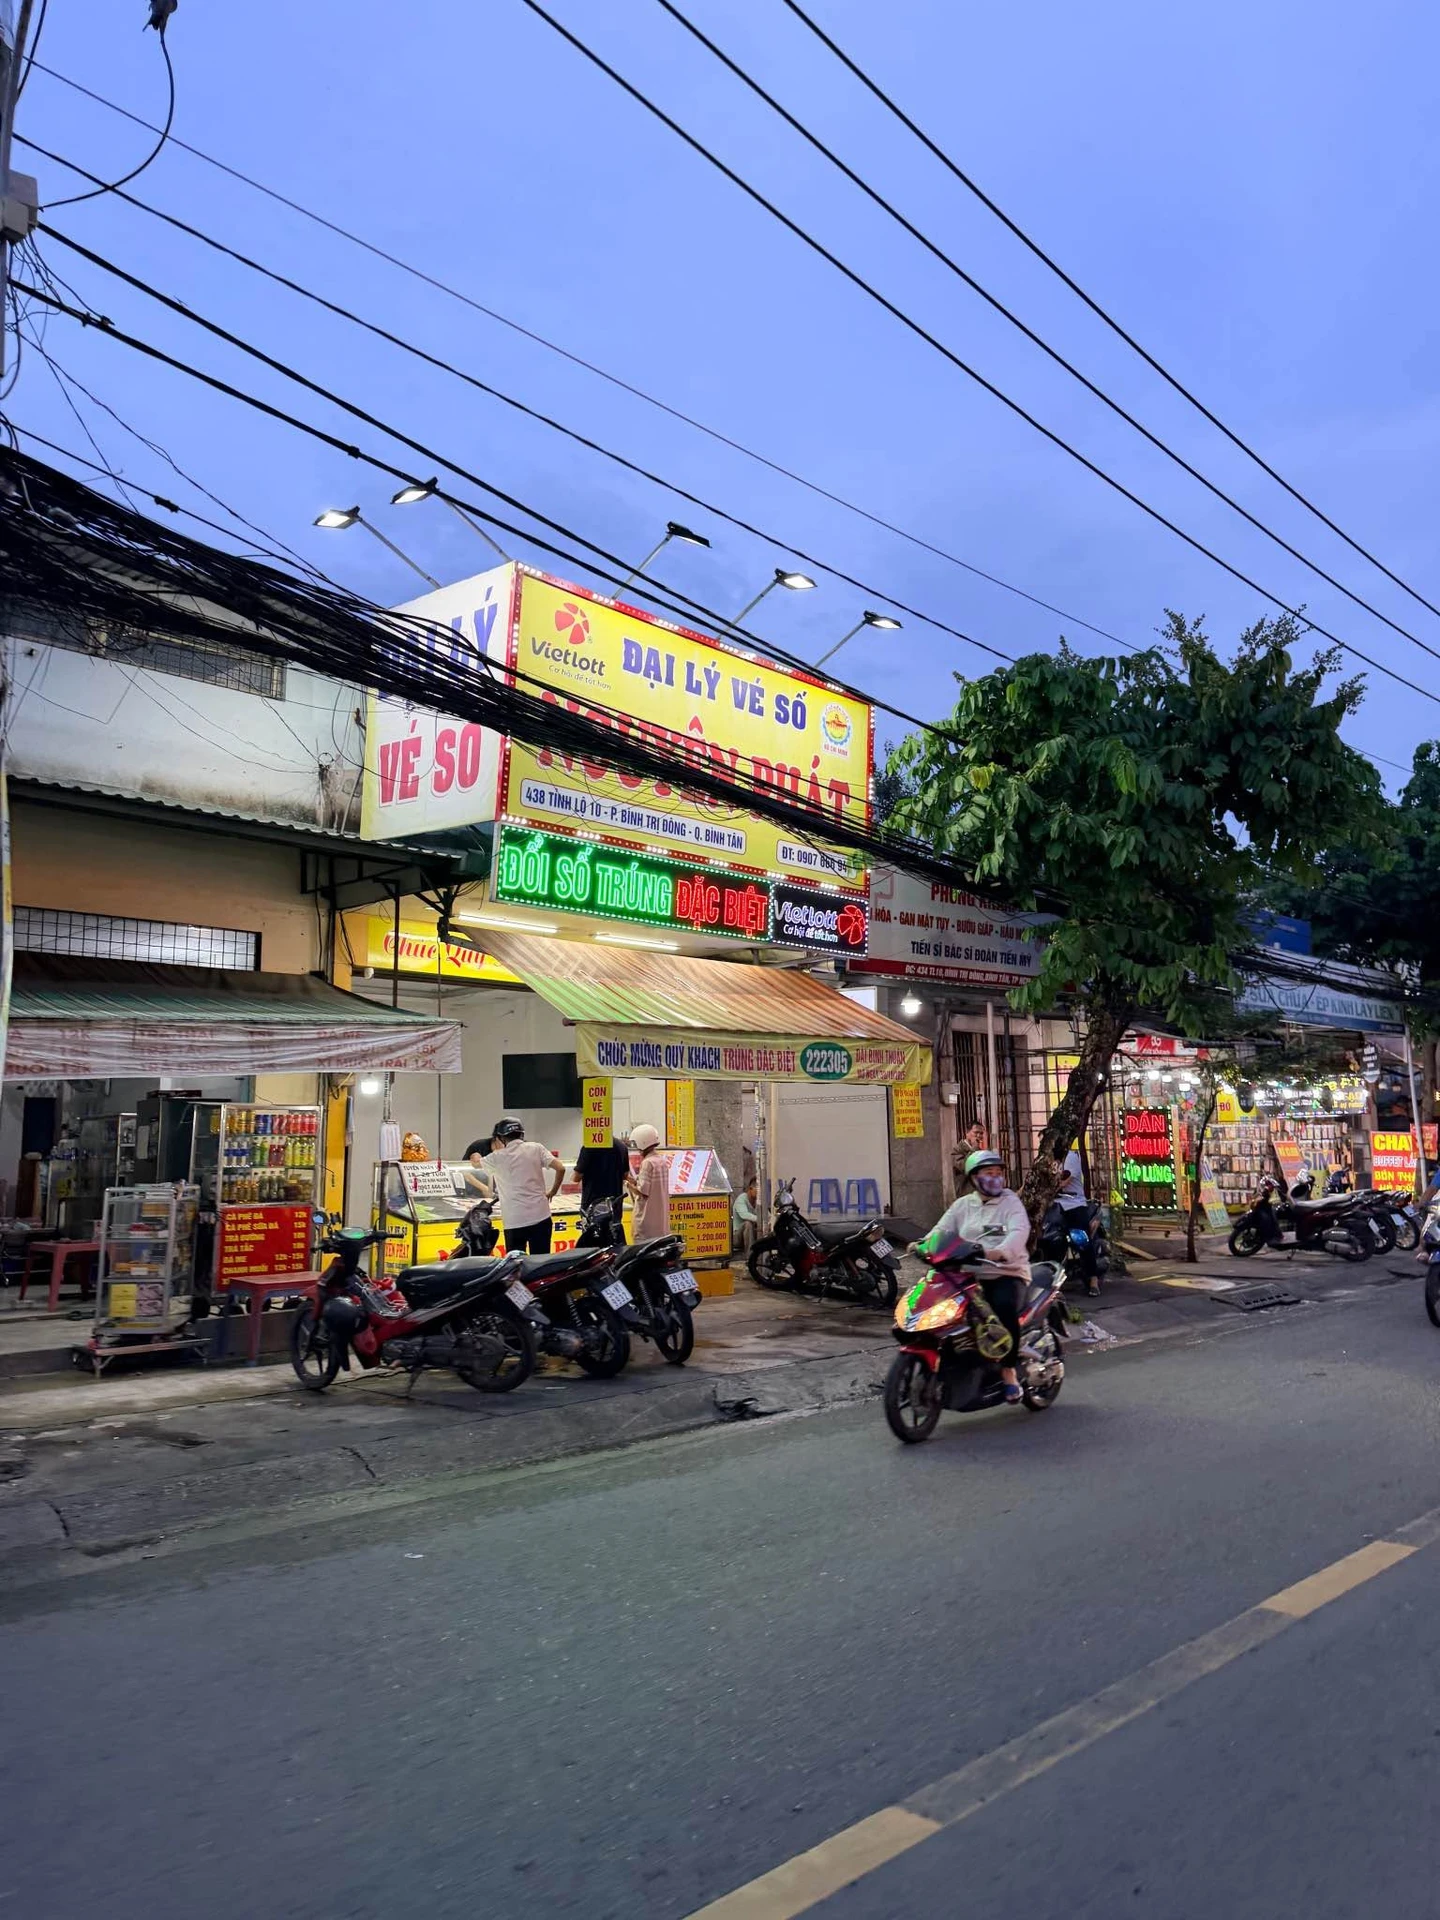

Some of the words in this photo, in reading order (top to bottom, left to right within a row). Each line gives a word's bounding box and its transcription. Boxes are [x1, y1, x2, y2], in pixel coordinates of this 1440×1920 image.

[531, 637, 605, 676] Vietlott
[622, 637, 675, 689] ĐẠI
[685, 660, 721, 700] LÝ
[731, 677, 765, 717] VÉ
[774, 691, 807, 730] SỐ
[379, 719, 422, 804] VÉ
[525, 786, 546, 805] 438
[548, 785, 572, 811] TỈNH
[574, 799, 587, 817] LỘ
[590, 803, 602, 817] 10
[610, 807, 618, 822] P.
[621, 806, 644, 828] BÌNH
[646, 814, 661, 834] TRỊ
[662, 816, 686, 837] ĐÔNG
[694, 826, 704, 841] Q.
[704, 826, 726, 845] BÌNH
[727, 830, 743, 850] TÂN
[782, 846, 795, 862] ĐT:
[797, 851, 818, 867] 0907
[502, 832, 550, 895] ĐỔI
[554, 847, 593, 902] SỐ
[595, 861, 673, 916] TRÚNG
[676, 875, 720, 929] ĐẶC
[723, 885, 768, 936] BIỆT
[773, 900, 838, 931] Vietlott
[899, 911, 916, 926] GAN
[911, 937, 931, 956] TIẾN
[944, 942, 962, 959] BÁC
[597, 1037, 628, 1067] CHÚC
[630, 1038, 663, 1068] MỪNG
[665, 1040, 685, 1071] QUÝ
[687, 1042, 721, 1070] KHÁCH
[723, 1043, 754, 1071] TRÚNG
[756, 1045, 776, 1076] ĐẶC
[777, 1046, 796, 1077] BIỆT
[806, 1049, 848, 1073] 222305
[1126, 1110, 1166, 1133] DÁN
